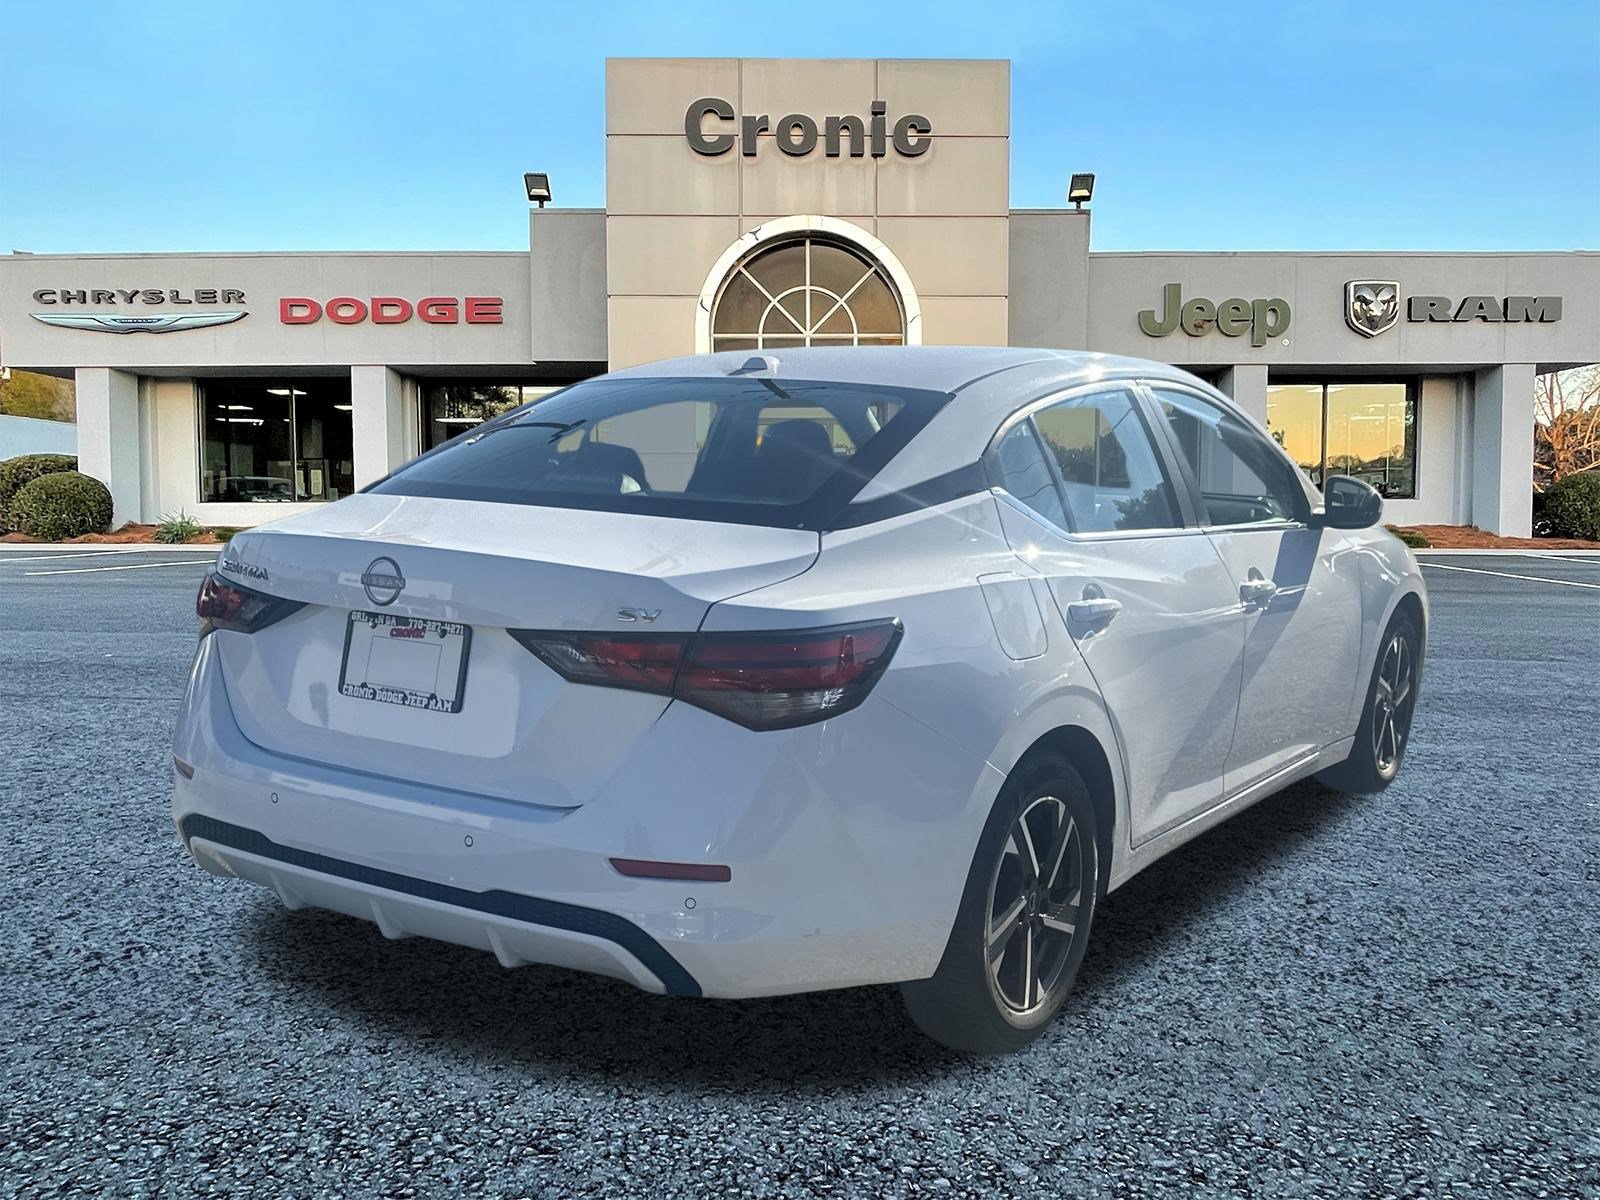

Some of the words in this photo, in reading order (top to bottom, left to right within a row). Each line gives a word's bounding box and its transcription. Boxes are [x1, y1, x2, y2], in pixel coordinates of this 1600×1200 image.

[685, 98, 932, 157] Cronic
[32, 288, 247, 305] CHRYSLER
[1407, 296, 1563, 323] RAM
[280, 297, 504, 325] DODGE
[1138, 283, 1292, 348] Jeep
[361, 574, 405, 588] NISSAN
[617, 607, 663, 624] SV
[342, 684, 374, 699] CRONIC
[375, 691, 404, 704] DODGE
[404, 695, 428, 708] JEEP
[428, 698, 453, 712] RAM
